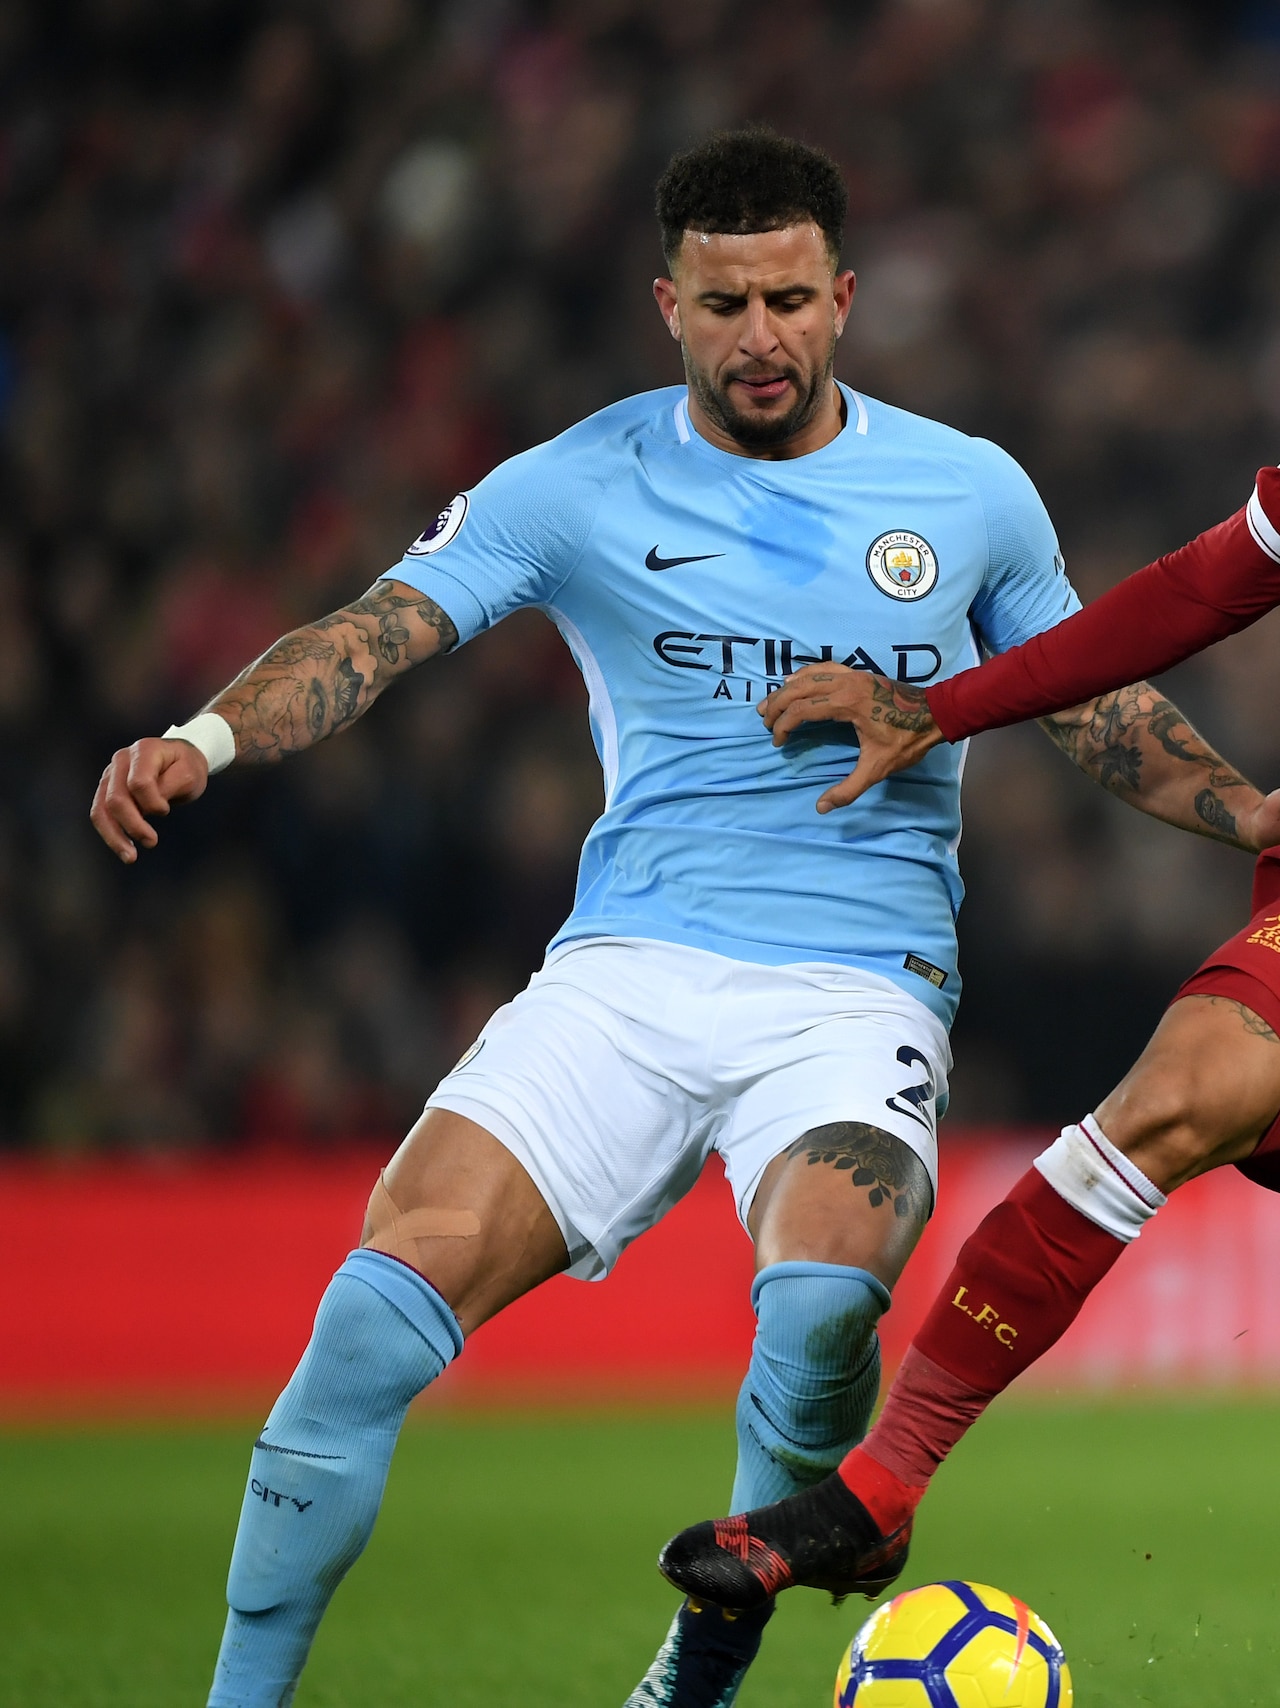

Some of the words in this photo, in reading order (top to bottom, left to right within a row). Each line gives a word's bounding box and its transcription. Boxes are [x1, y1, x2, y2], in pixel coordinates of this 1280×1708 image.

[873, 534, 930, 558] MANCHESTER
[897, 588, 917, 596] CITY
[653, 631, 942, 683] ETIHAD
[896, 1046, 934, 1131] 2
[952, 1286, 1018, 1350] L.F.C.
[251, 1478, 313, 1512] CITY
